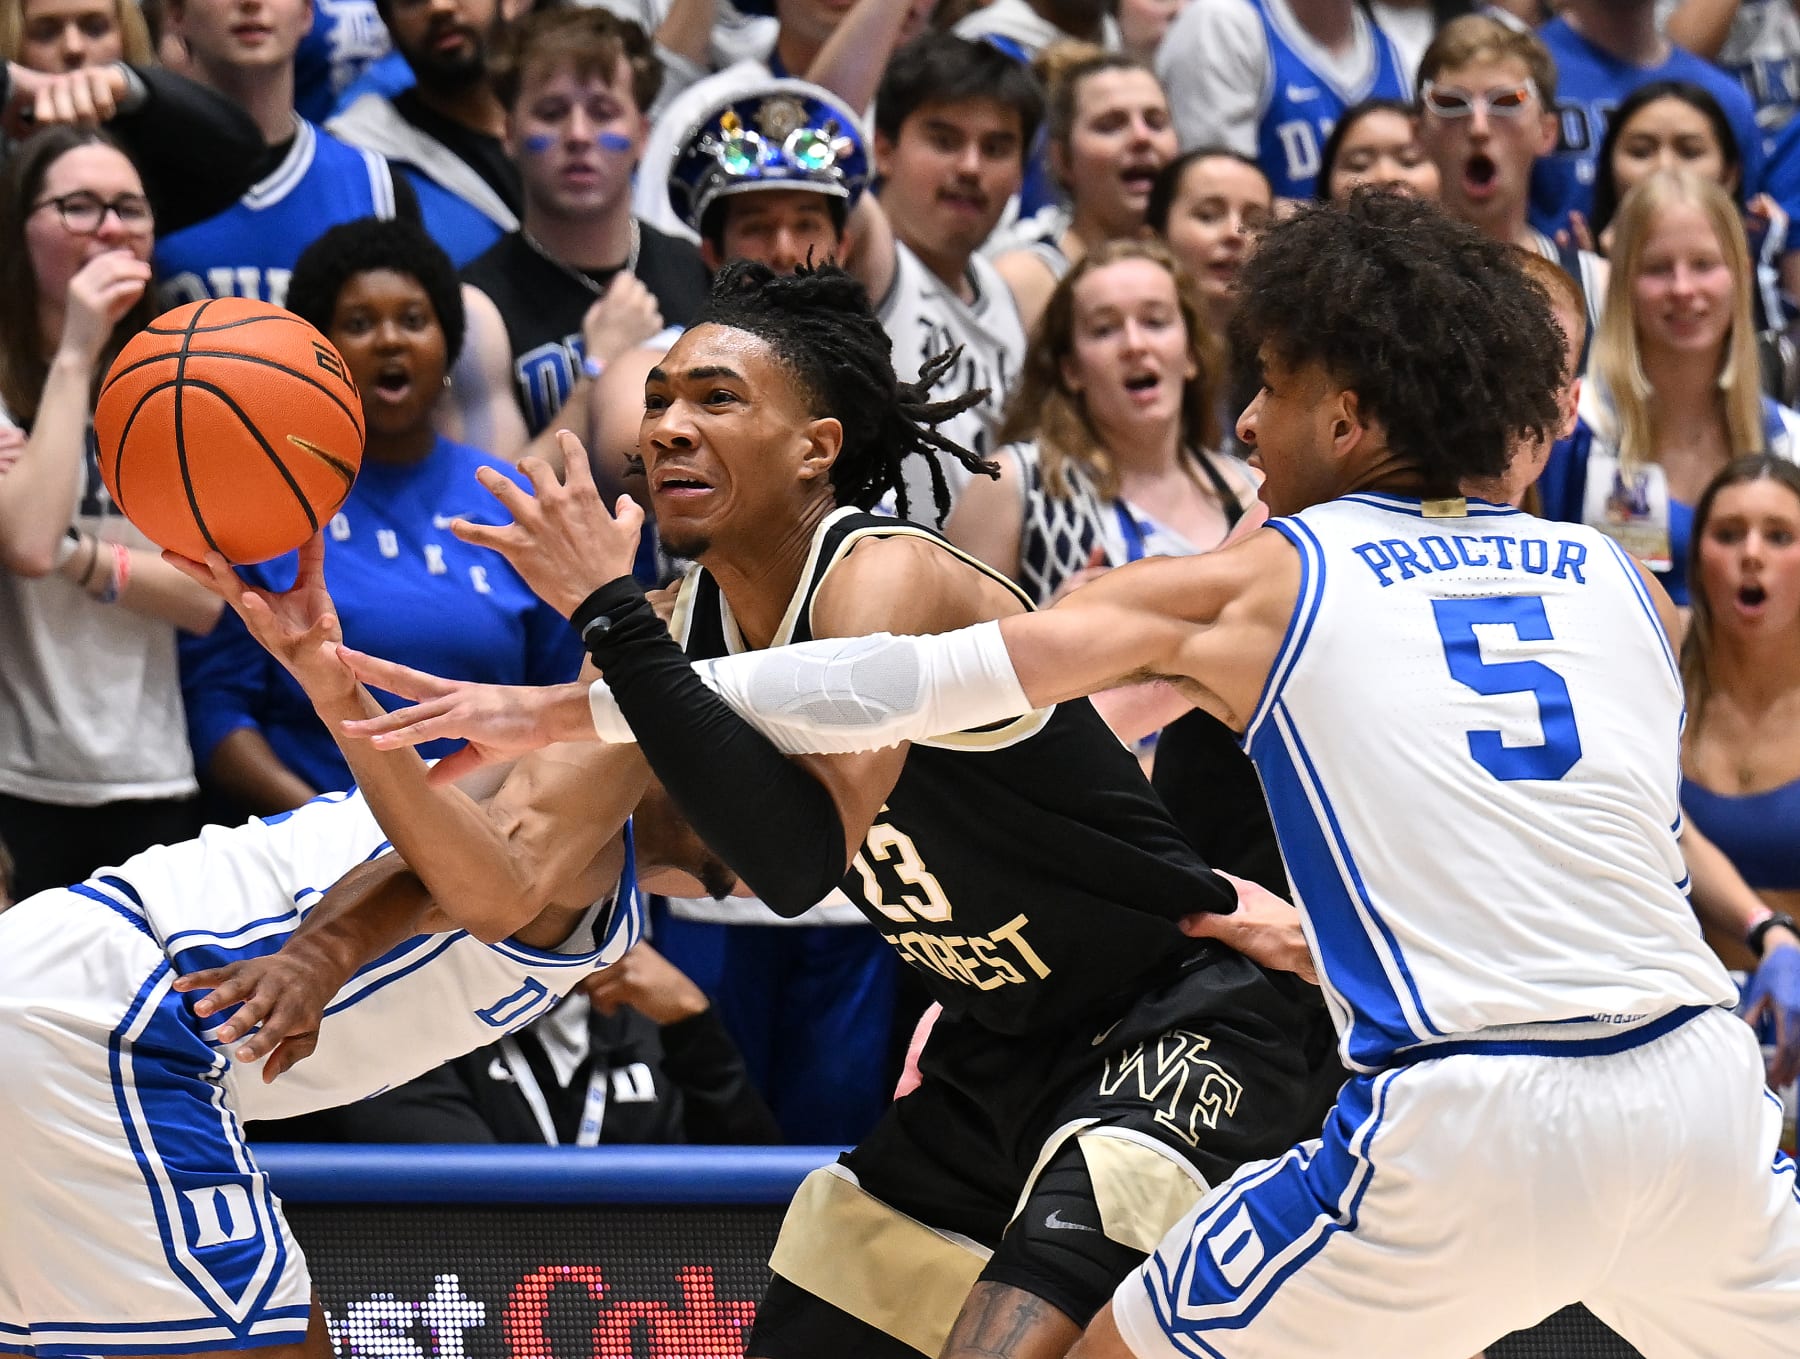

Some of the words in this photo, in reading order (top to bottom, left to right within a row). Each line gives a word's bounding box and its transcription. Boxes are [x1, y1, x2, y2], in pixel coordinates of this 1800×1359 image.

[1351, 535, 1588, 588] PROCTOR
[1430, 596, 1583, 782] 5
[182, 1183, 257, 1248] D
[1207, 1201, 1265, 1288] D
